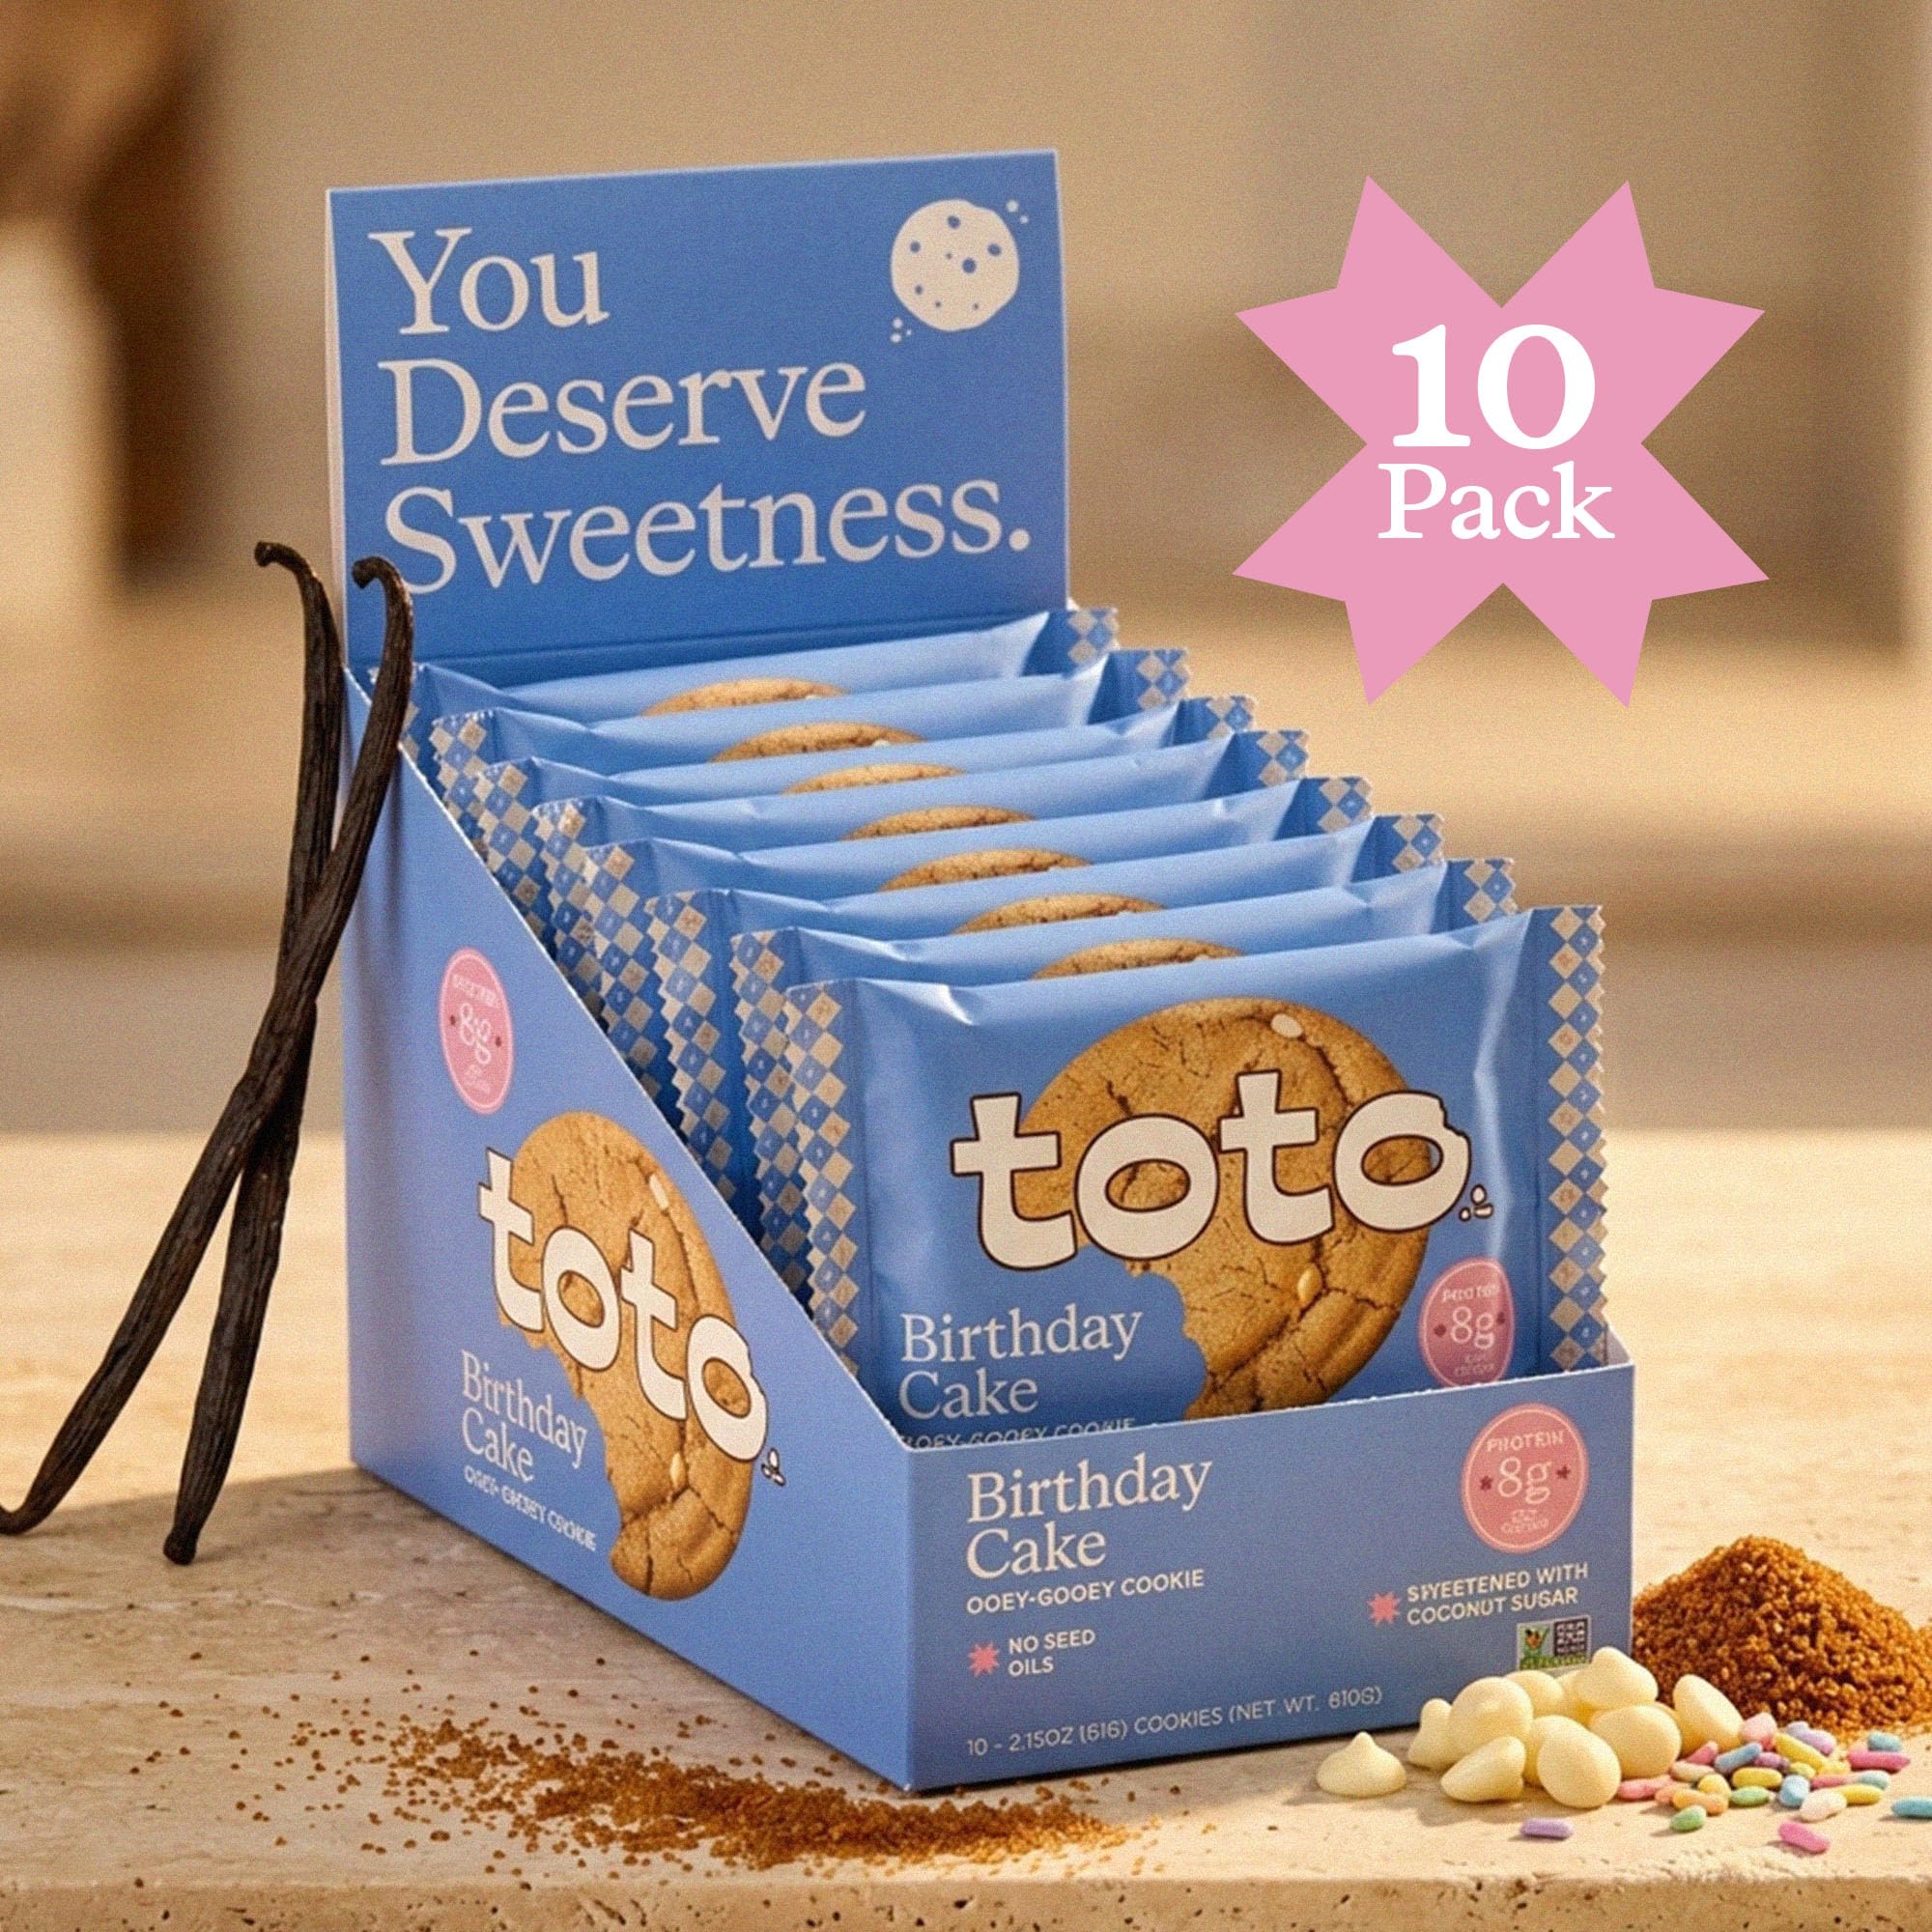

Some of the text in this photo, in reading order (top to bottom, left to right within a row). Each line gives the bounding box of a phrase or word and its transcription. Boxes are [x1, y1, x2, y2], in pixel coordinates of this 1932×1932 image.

[368, 227, 611, 335] You
[377, 357, 867, 466] Deserve
[384, 479, 1032, 595] Sweetness.
[899, 1302, 1143, 1362] Birthday
[1450, 1305, 1495, 1350] 8g
[461, 1350, 588, 1469] Birthday
[898, 1366, 1039, 1420] Cake
[462, 1406, 534, 1483] Cake
[967, 1451, 1213, 1523] Birthday
[1498, 1456, 1552, 1505] 8g
[966, 1520, 1107, 1579] Cake
[1536, 1562, 1589, 1585] WITH
[966, 1568, 1206, 1615] OOEY-GOOEY COOKIE
[1406, 1586, 1579, 1626] COCONUT SUGAR
[1008, 1629, 1096, 1654] NO SEED
[1008, 1656, 1054, 1677] OILS
[968, 1738, 988, 1756] 10
[1133, 1707, 1223, 1735] COOKIES
[1228, 1700, 1276, 1723] (NET
